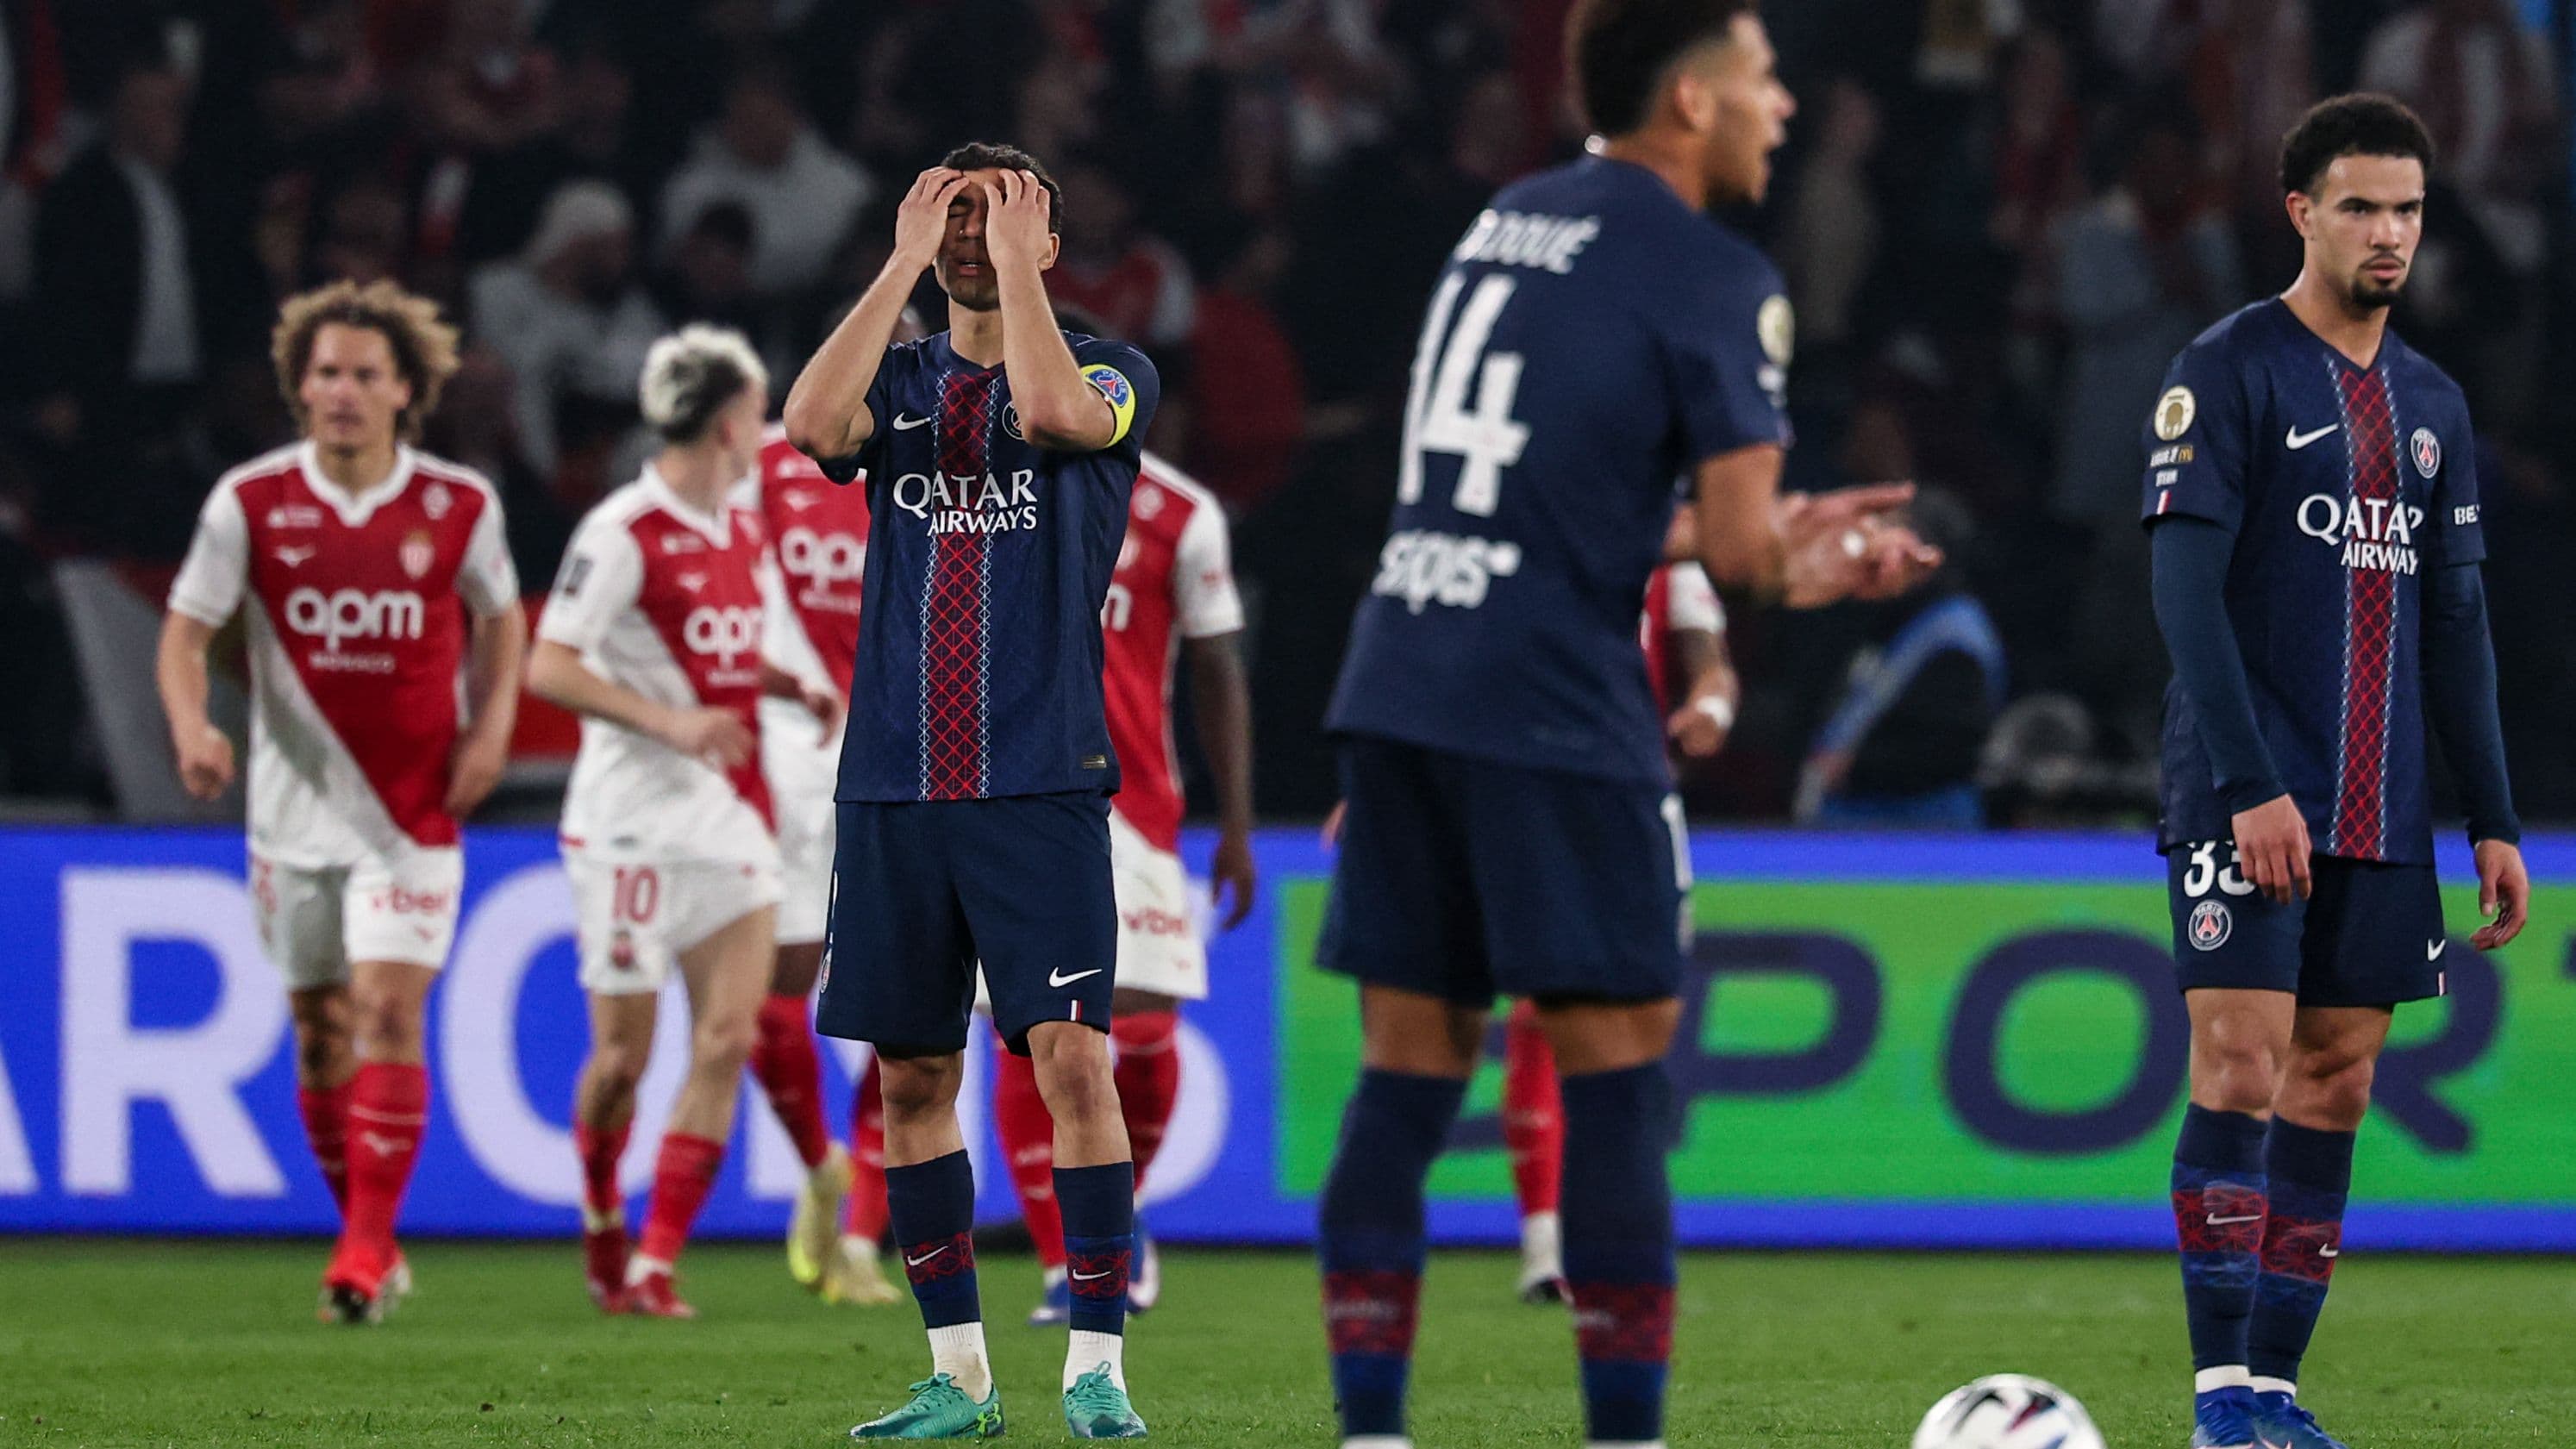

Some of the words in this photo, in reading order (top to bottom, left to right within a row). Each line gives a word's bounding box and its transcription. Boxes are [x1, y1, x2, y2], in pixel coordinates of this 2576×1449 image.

[1397, 272, 1531, 517] 14
[893, 468, 1038, 520] QATAR
[2454, 503, 2480, 526] BE
[927, 505, 1038, 537] AIRWAYS
[284, 586, 425, 655] apm
[613, 865, 659, 923] 10
[2195, 902, 2224, 916] PARIS
